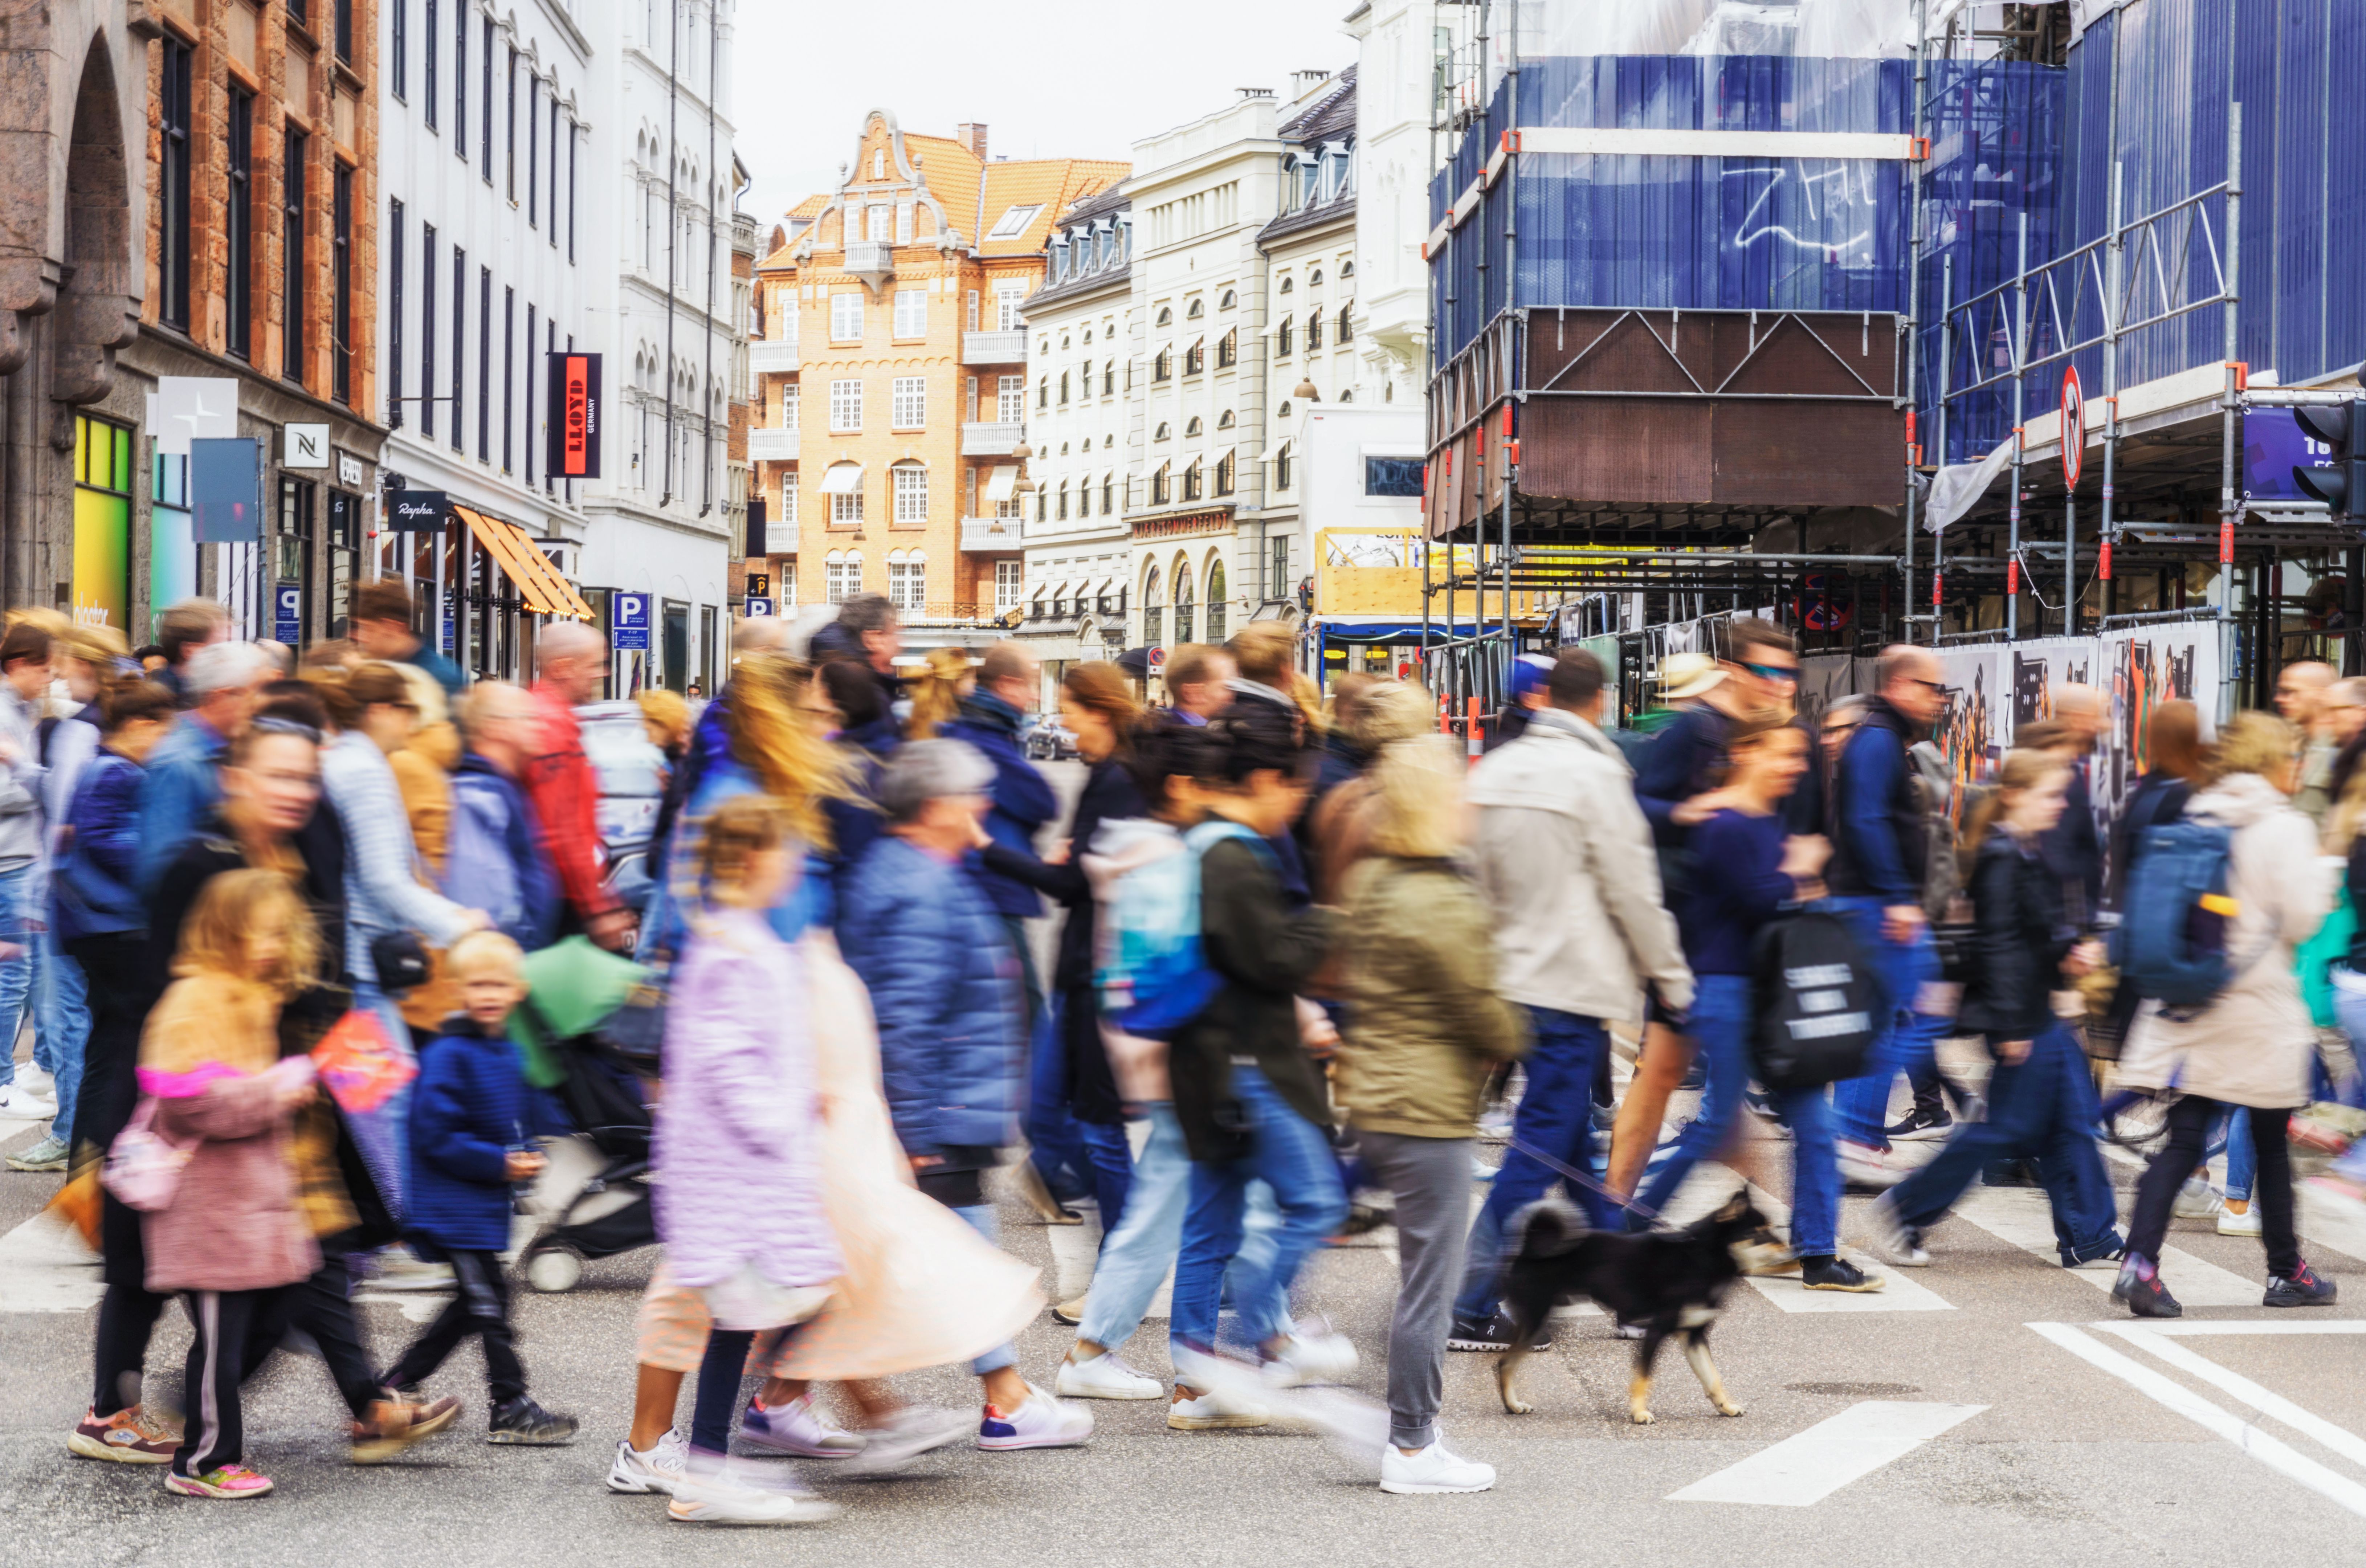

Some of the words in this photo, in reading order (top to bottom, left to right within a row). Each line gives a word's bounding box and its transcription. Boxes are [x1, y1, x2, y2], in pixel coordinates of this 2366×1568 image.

[569, 380, 583, 451] LLOYD
[291, 432, 323, 459] N
[621, 597, 641, 624] P
[751, 601, 767, 617] P
